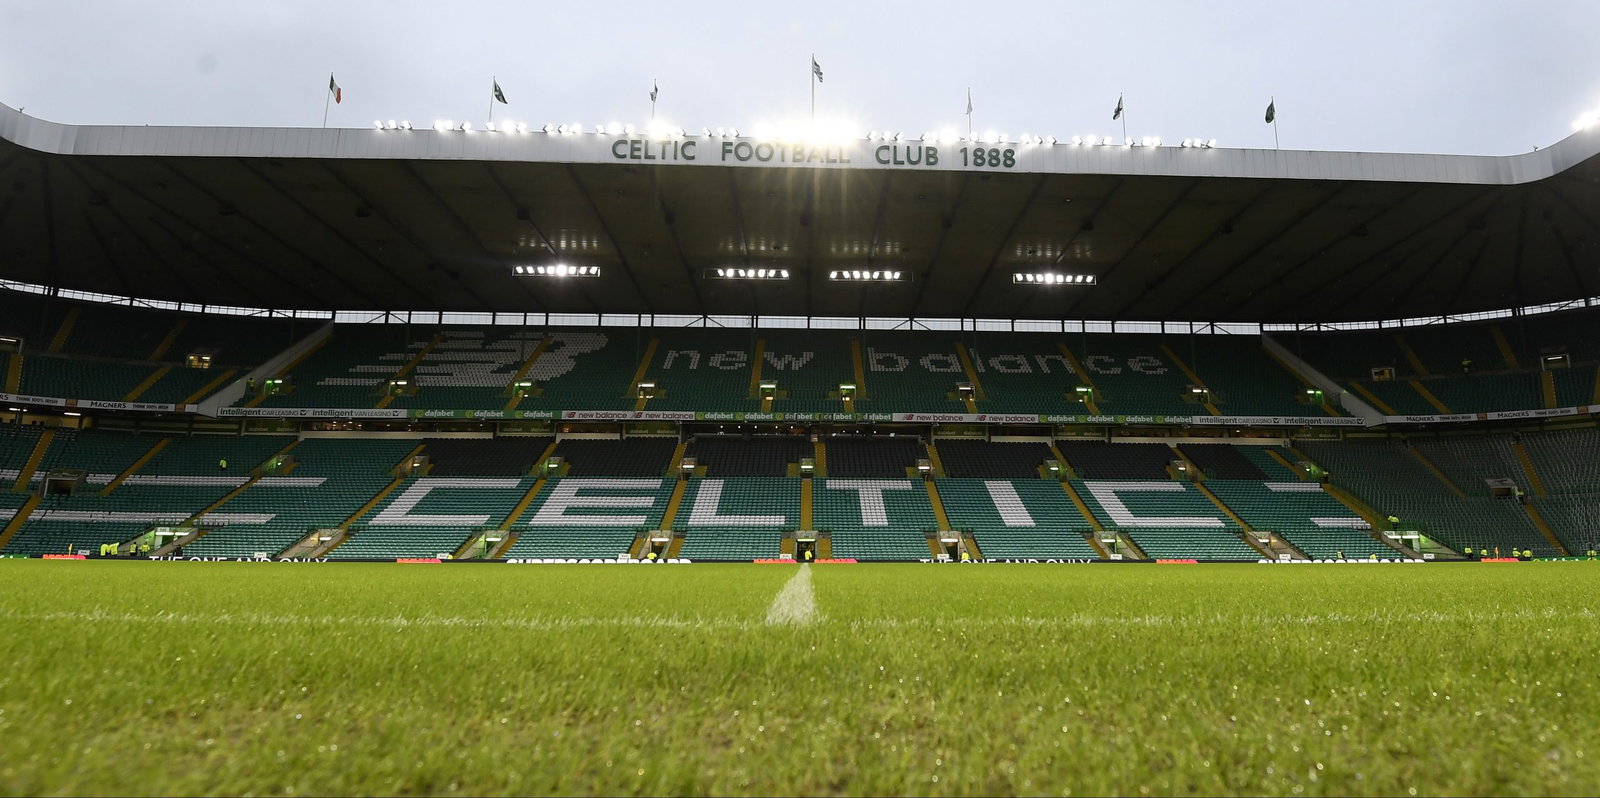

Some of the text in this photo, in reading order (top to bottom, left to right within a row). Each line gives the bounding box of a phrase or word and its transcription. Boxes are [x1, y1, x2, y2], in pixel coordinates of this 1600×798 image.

[611, 139, 1016, 169] CELTIC FOOTBALL CLUB 1888
[663, 347, 1168, 375] new balance
[90, 401, 127, 409] MAGNERS
[220, 408, 261, 417] intelligent
[312, 409, 353, 417] intelligent
[425, 409, 454, 418] dafabet
[474, 410, 504, 418] dafabet
[523, 410, 553, 418] dafabet
[662, 412, 694, 420] balance
[1497, 411, 1530, 419] MAGNERS
[1047, 415, 1076, 423] dafabet
[1086, 415, 1114, 423] dafabet
[1125, 415, 1153, 423] dafabet
[1164, 416, 1193, 424] dafabet
[1199, 416, 1238, 425] intelligent
[1284, 417, 1322, 425] intelligent
[368, 478, 1226, 529] CELTIC
